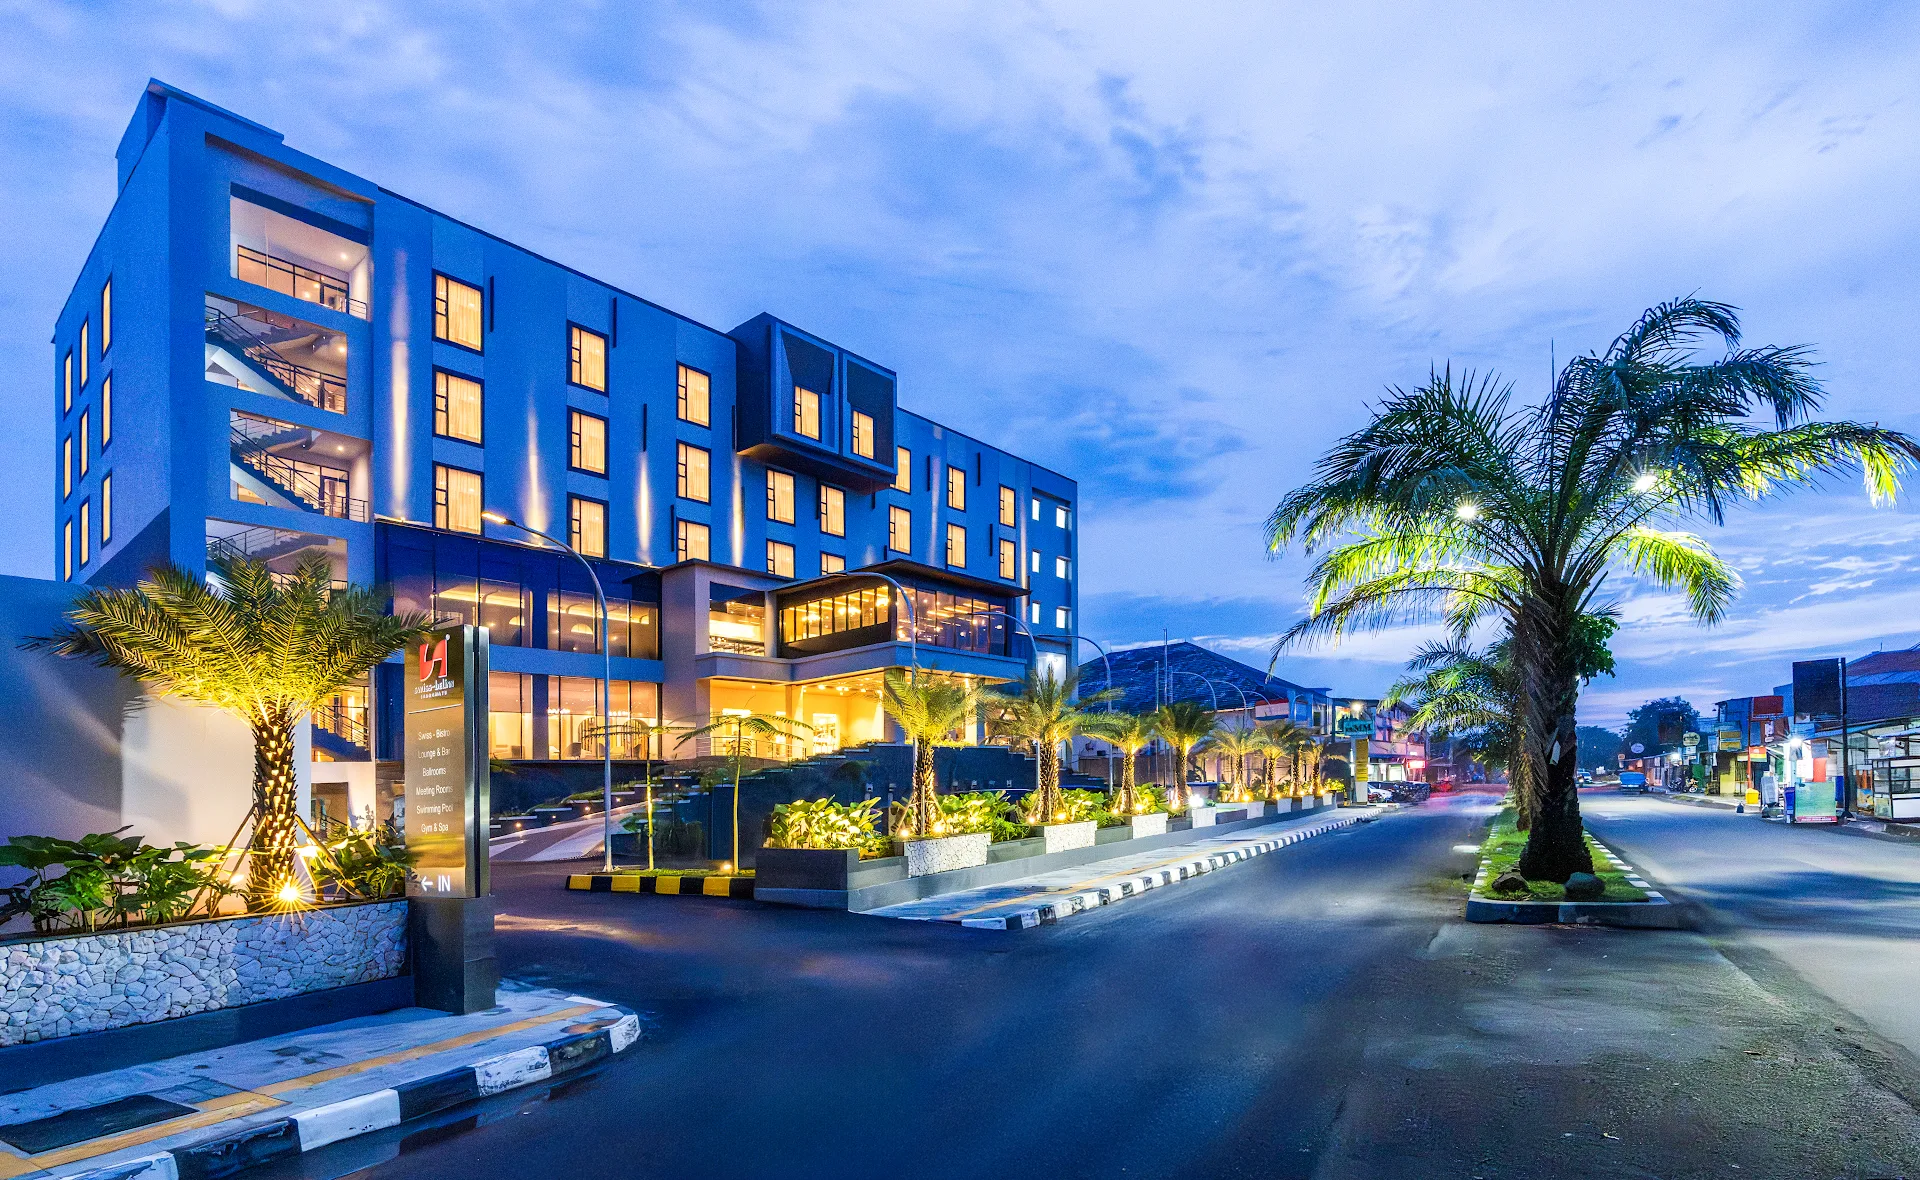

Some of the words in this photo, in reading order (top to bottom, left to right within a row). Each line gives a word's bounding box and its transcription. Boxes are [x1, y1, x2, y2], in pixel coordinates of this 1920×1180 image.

[418, 731, 432, 741] Swiss
[436, 728, 450, 738] Bistro
[418, 750, 436, 760] Lounge
[437, 747, 441, 757] &
[441, 746, 450, 756] Bar
[422, 767, 446, 777] Ballrooms
[416, 786, 435, 797] Meeting
[435, 784, 453, 794] Rooms
[416, 805, 441, 815] Swimming
[441, 803, 454, 813] Pool
[421, 823, 433, 835] Gym
[433, 822, 438, 832] &
[438, 822, 449, 833] Spa
[438, 874, 451, 892] IN
